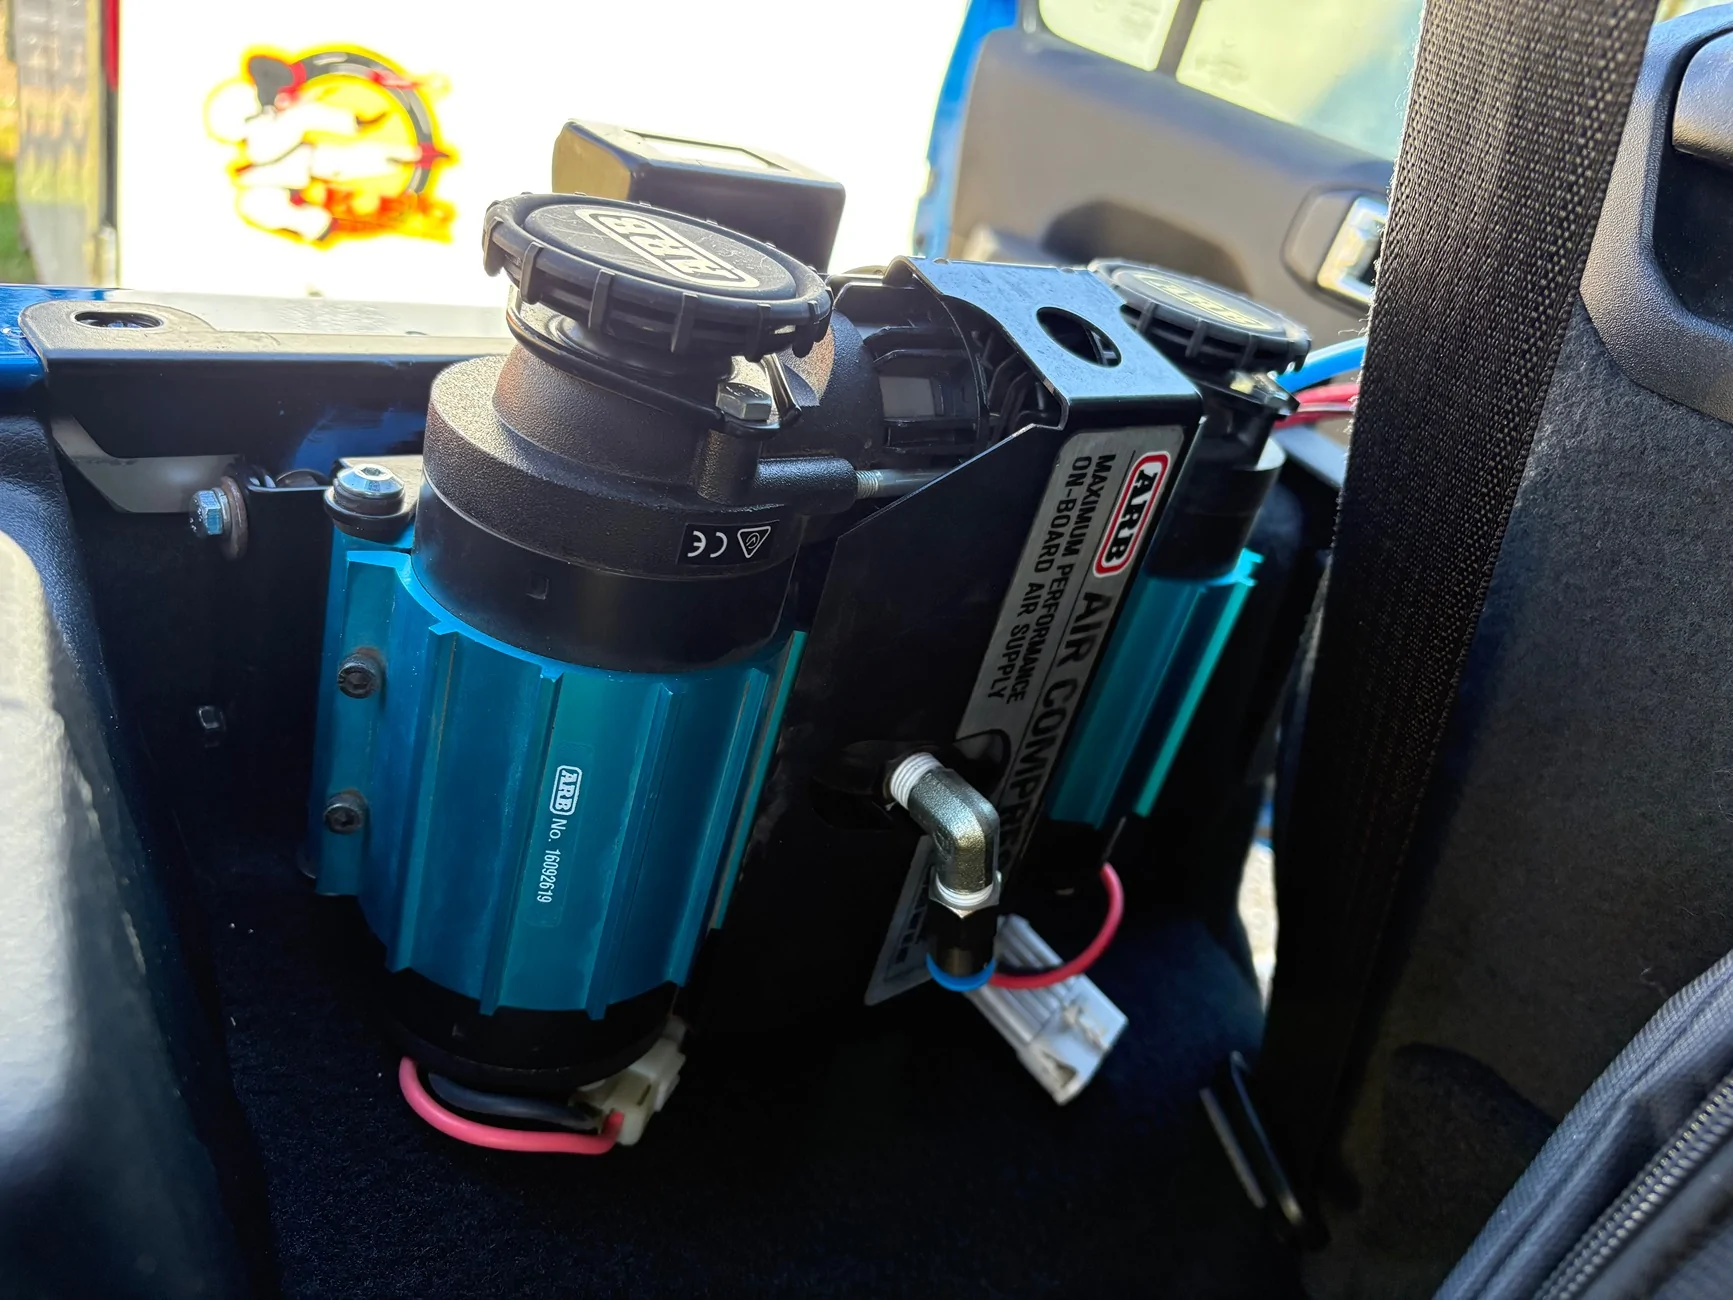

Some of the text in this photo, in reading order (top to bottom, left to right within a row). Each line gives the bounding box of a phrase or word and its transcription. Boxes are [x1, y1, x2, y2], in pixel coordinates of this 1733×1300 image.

[597, 216, 740, 281] ARB
[1104, 468, 1158, 564] ARB
[987, 456, 1086, 700] ON-BOARD AIR SUPPLY
[1006, 454, 1117, 705] MAXIMUM PERFORMANCE
[1056, 591, 1113, 668] AIR
[536, 769, 578, 904] ARB No. 16092619
